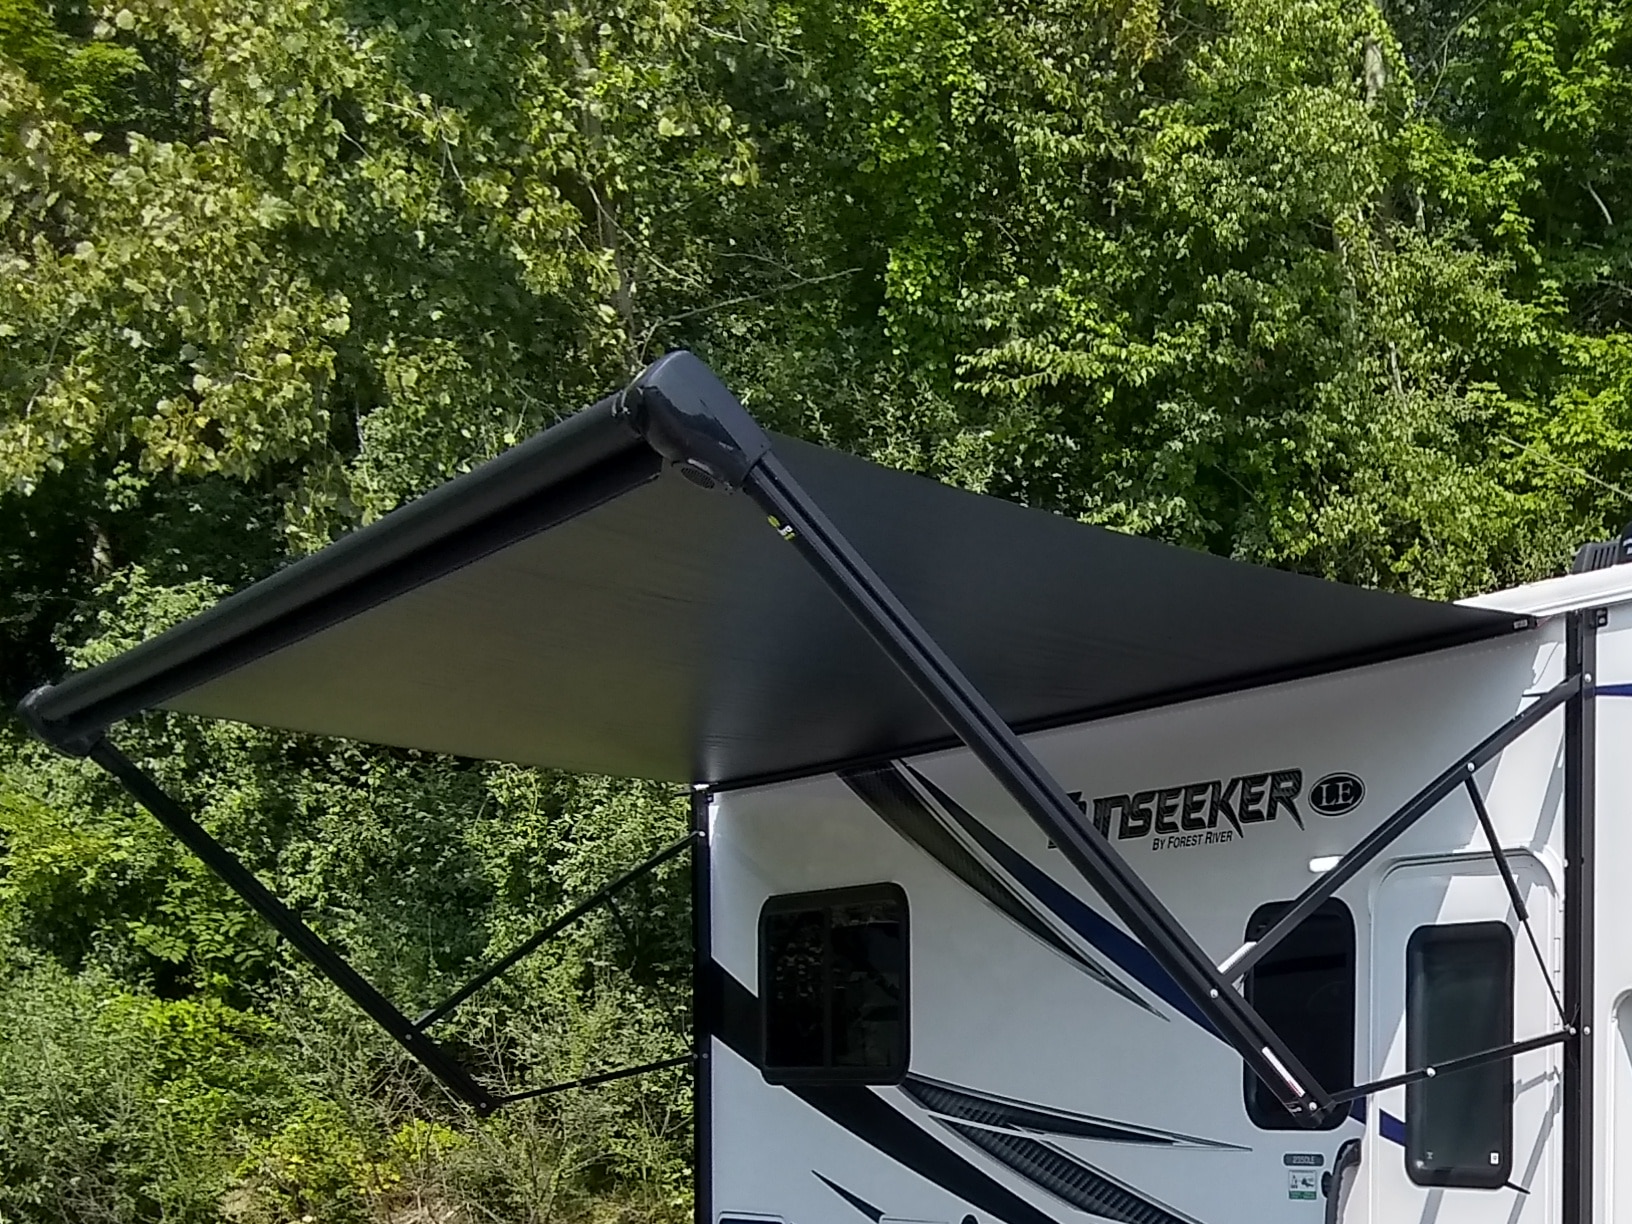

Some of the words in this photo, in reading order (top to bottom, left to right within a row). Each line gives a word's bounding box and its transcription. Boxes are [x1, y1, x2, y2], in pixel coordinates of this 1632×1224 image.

[1047, 768, 1304, 849] NSEEKER
[1319, 779, 1354, 808] LE
[1152, 838, 1166, 851] BY
[1167, 834, 1203, 848] FOREST
[1205, 830, 1233, 844] RIVER
